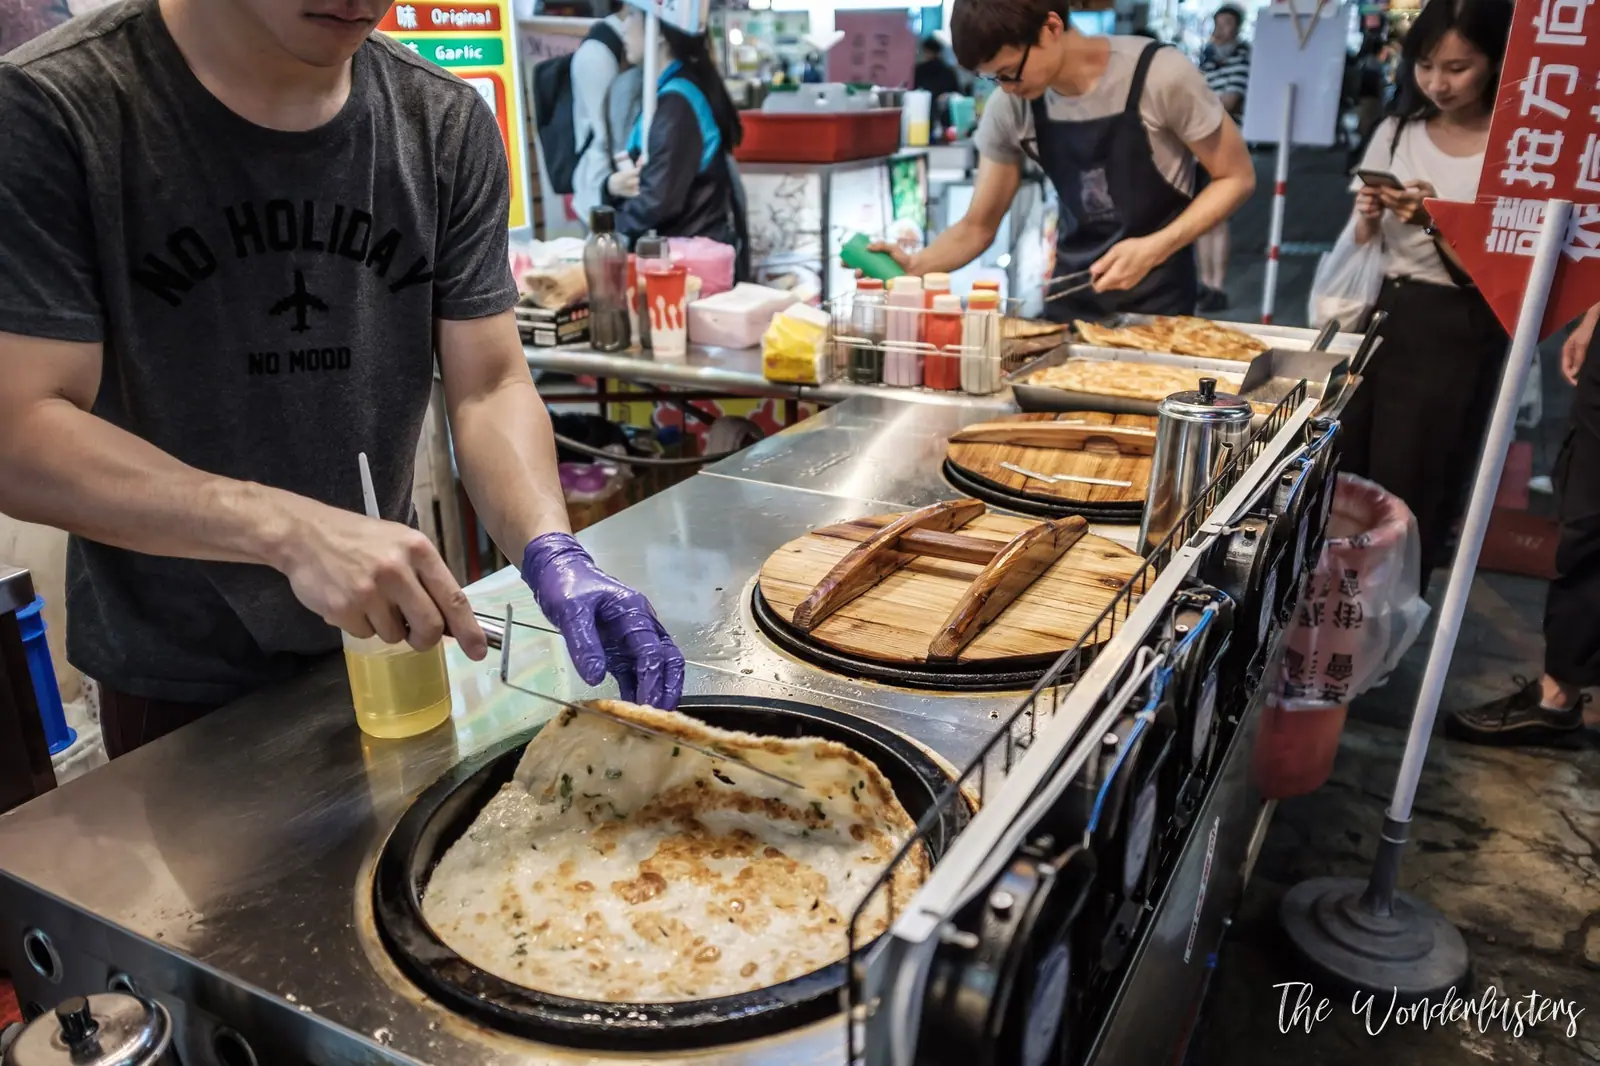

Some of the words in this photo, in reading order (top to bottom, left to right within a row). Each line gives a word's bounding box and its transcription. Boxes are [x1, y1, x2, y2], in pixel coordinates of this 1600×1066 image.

[431, 8, 492, 28] Original
[435, 44, 484, 60] Garlic
[131, 227, 217, 307] NO
[226, 200, 434, 294] HOLIDAY
[249, 353, 280, 375] NO
[289, 347, 351, 373] MOOD
